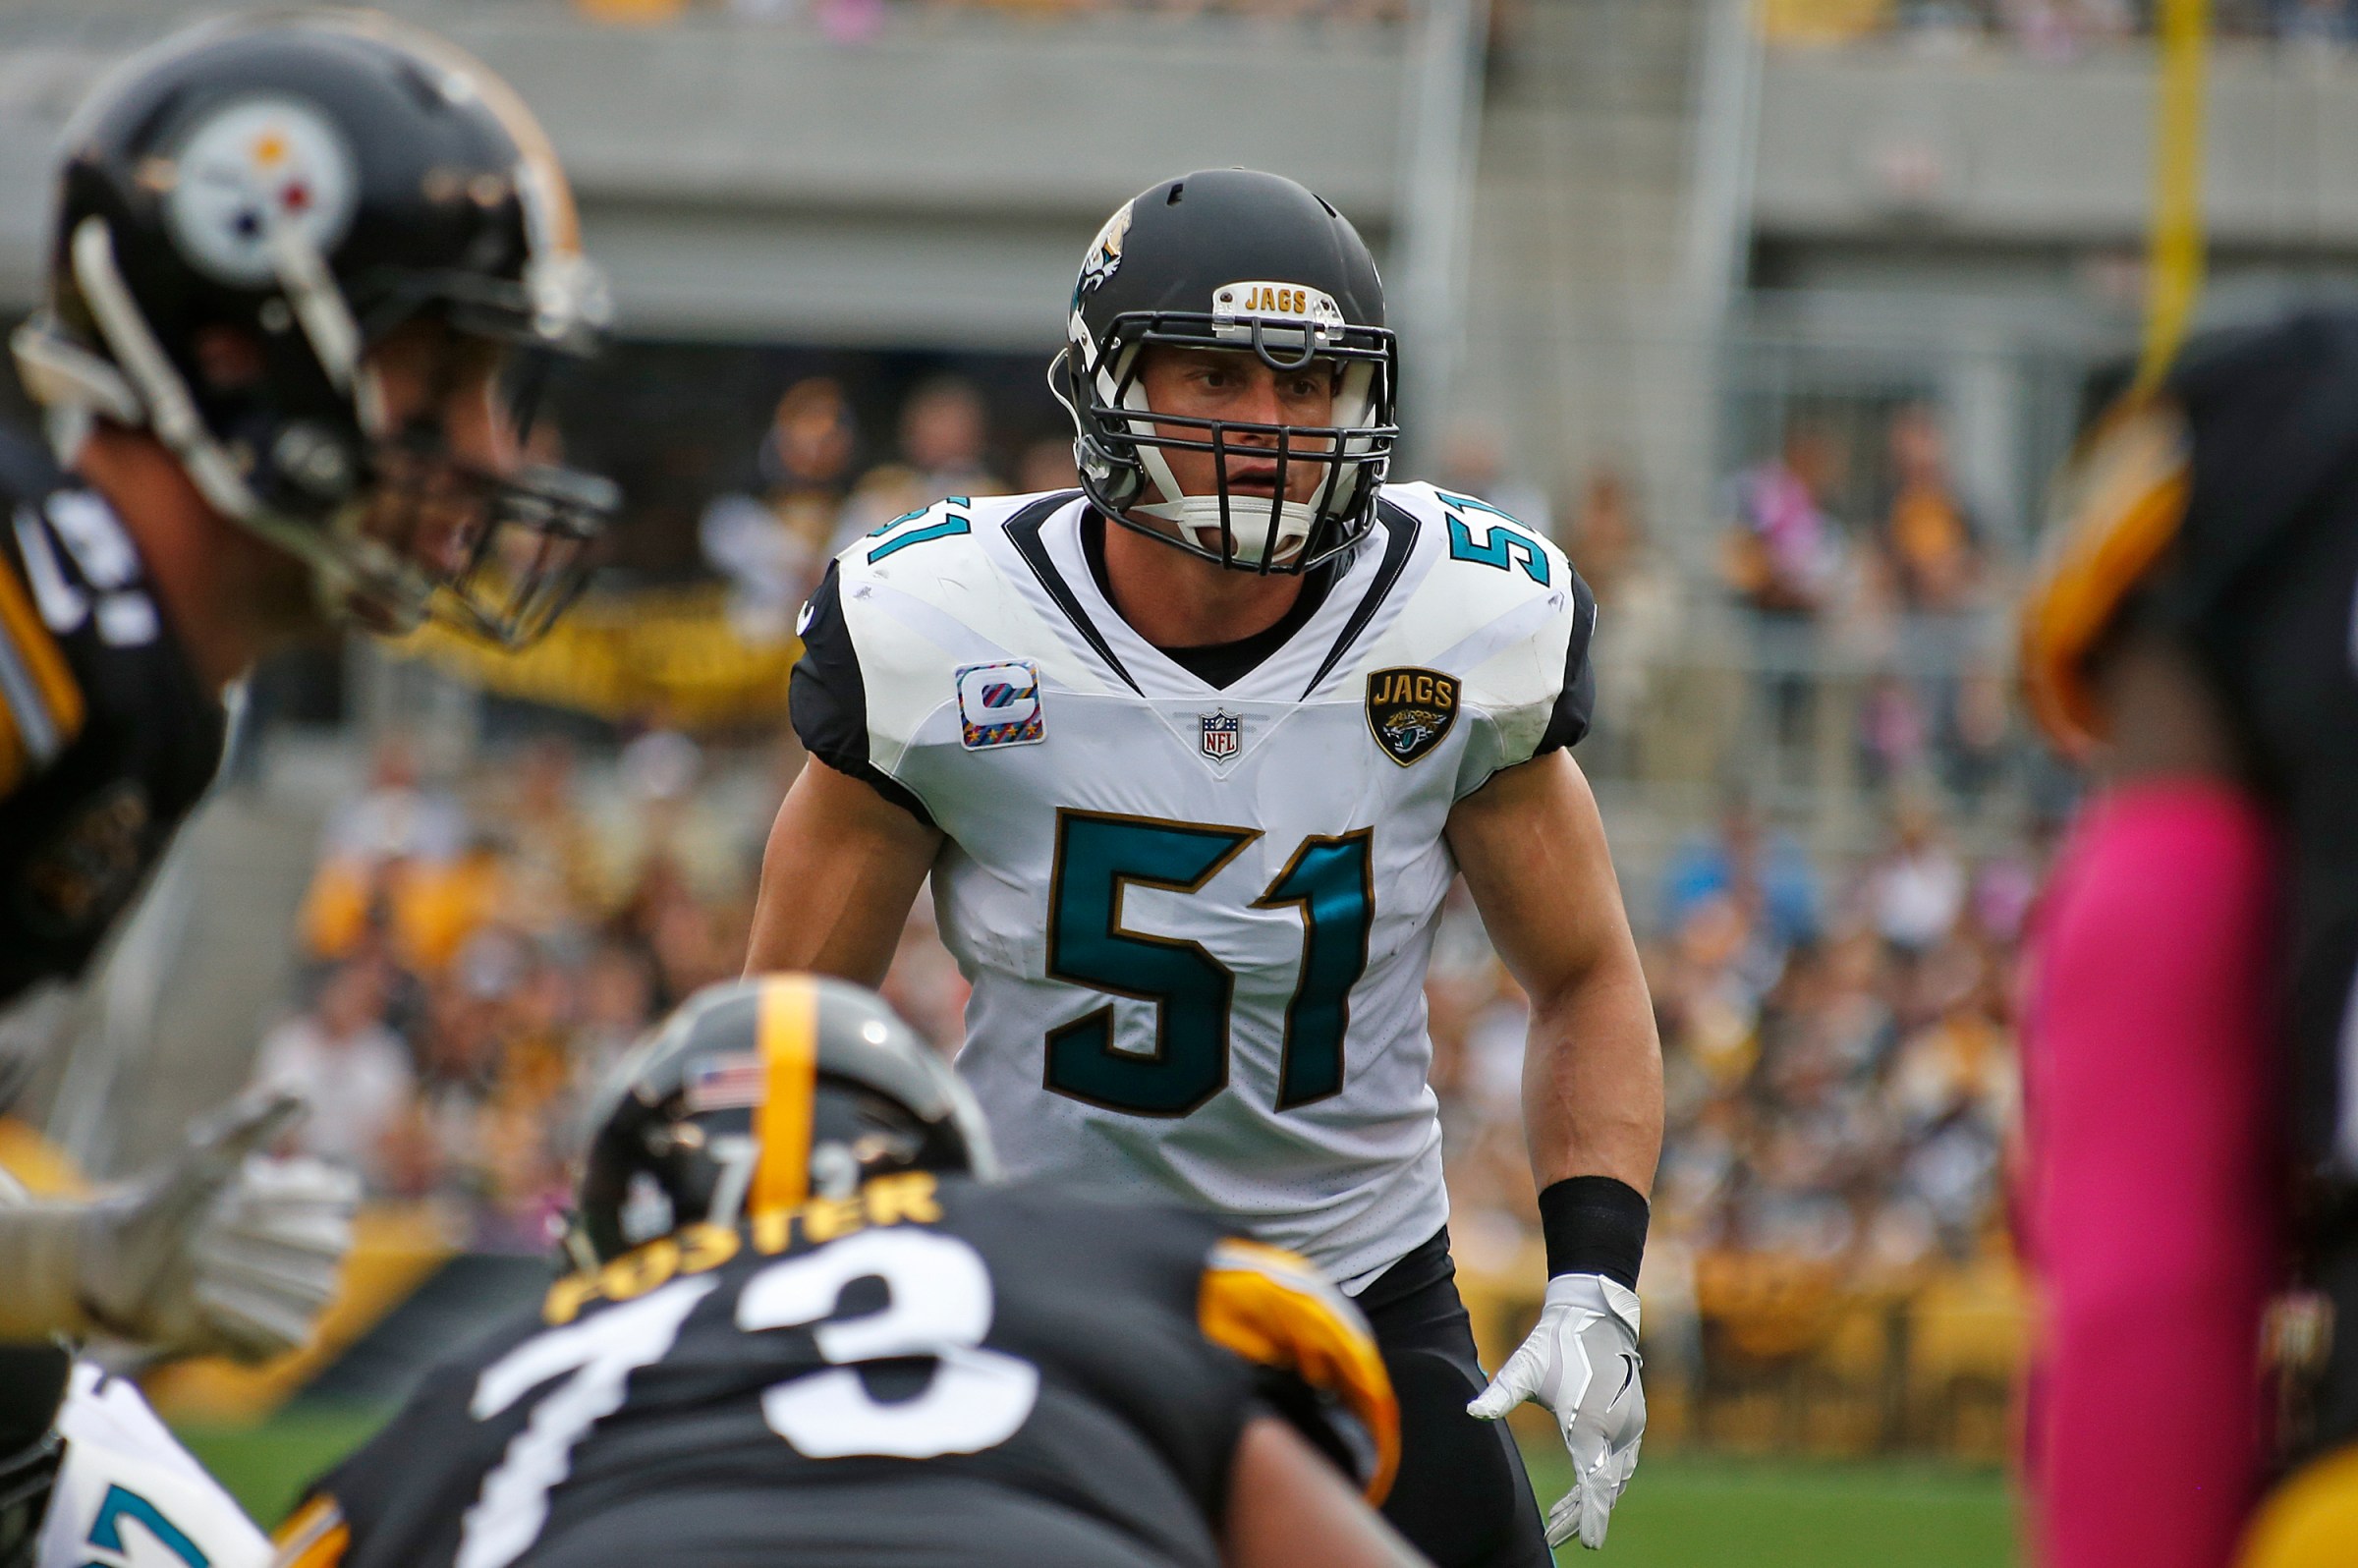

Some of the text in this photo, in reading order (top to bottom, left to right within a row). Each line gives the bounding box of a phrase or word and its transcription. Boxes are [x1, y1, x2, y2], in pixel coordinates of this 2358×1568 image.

[1245, 287, 1306, 313] JAGS
[962, 665, 1037, 726] C
[1374, 674, 1452, 709] JAGS
[1206, 732, 1236, 754] NFL
[1042, 806, 1376, 1118] 51
[542, 1170, 944, 1326] FOSTER
[455, 1227, 1040, 1568] 73
